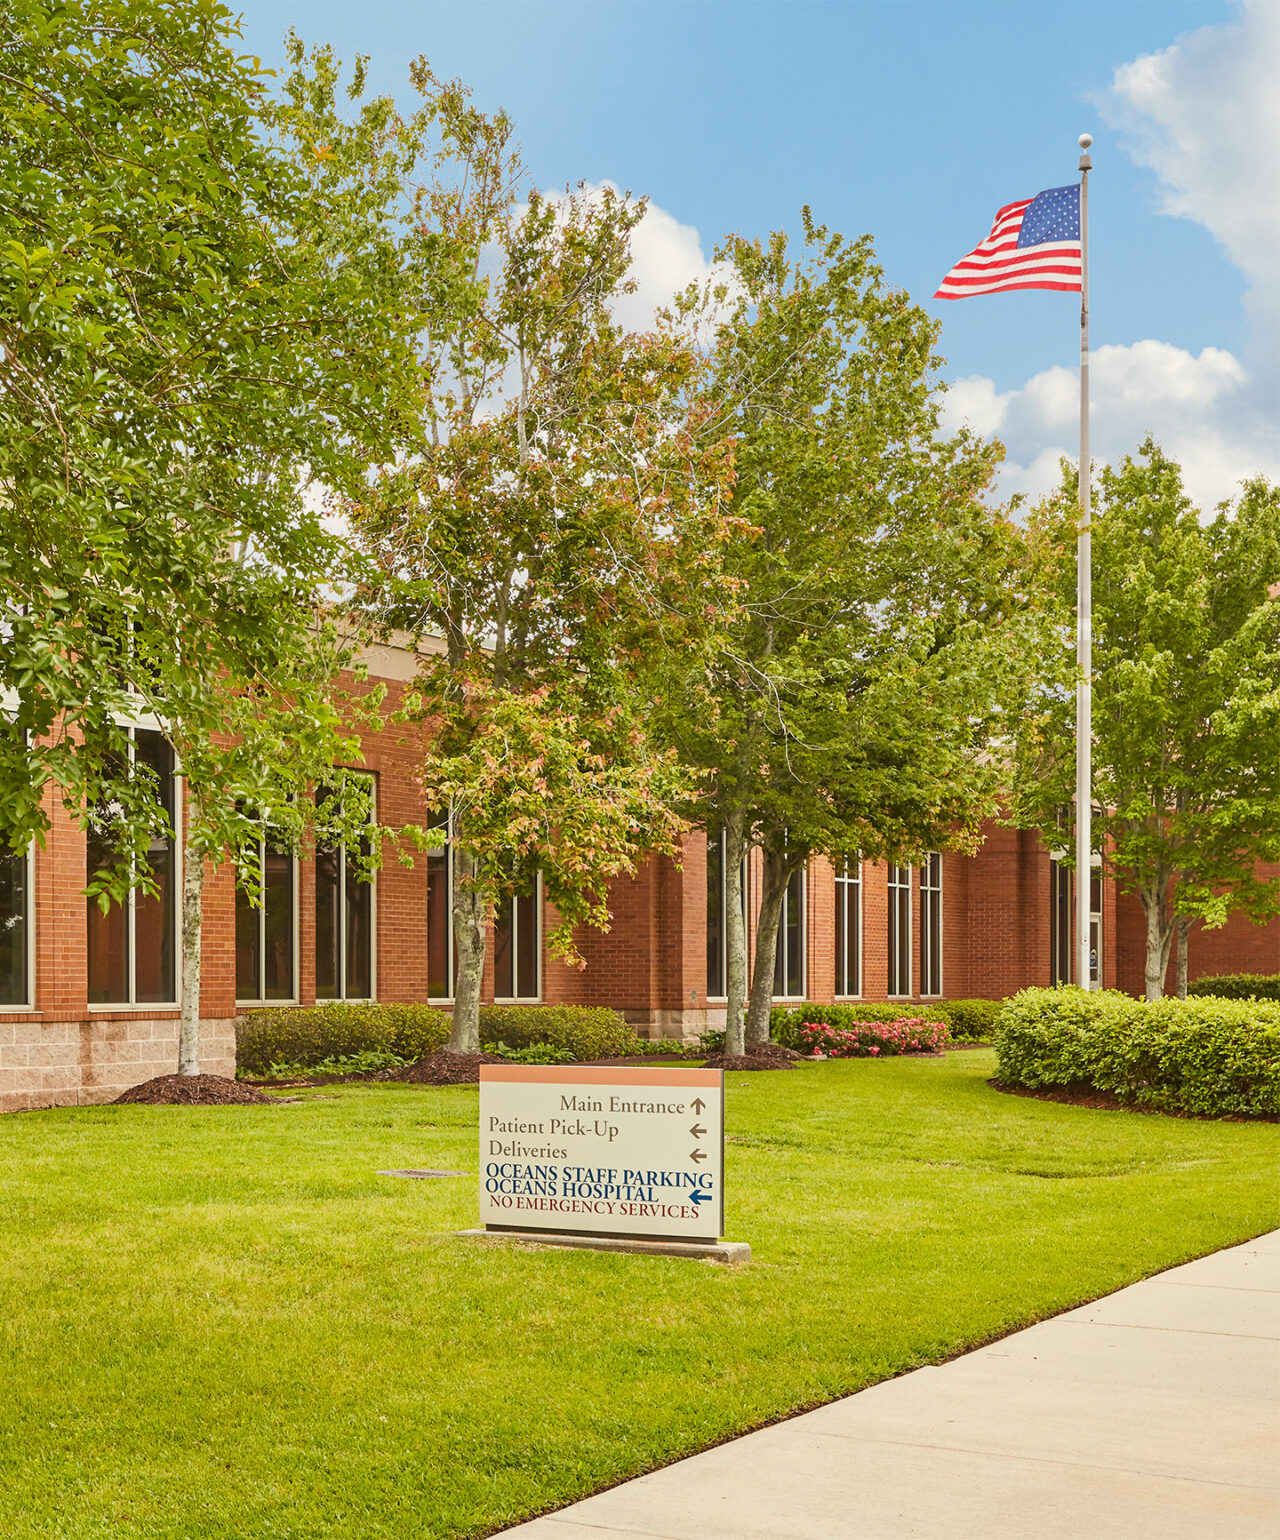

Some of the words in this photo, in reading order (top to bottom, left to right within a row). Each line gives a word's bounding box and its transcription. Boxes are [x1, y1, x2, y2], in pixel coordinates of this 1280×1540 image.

[560, 1095, 602, 1112] Main
[609, 1096, 685, 1114] Entrance
[489, 1116, 544, 1134] Patient
[550, 1118, 619, 1142] Pick-Up
[489, 1140, 568, 1159] Deliveries
[486, 1162, 558, 1181] OCEANS
[562, 1166, 618, 1184] STAFF
[623, 1169, 714, 1189] PARKING
[485, 1178, 557, 1196] OCEANS
[562, 1182, 659, 1202] HOSPITAL
[490, 1195, 513, 1208] NO
[516, 1197, 616, 1214] EMERGENCY
[620, 1202, 700, 1219] SERVICES
